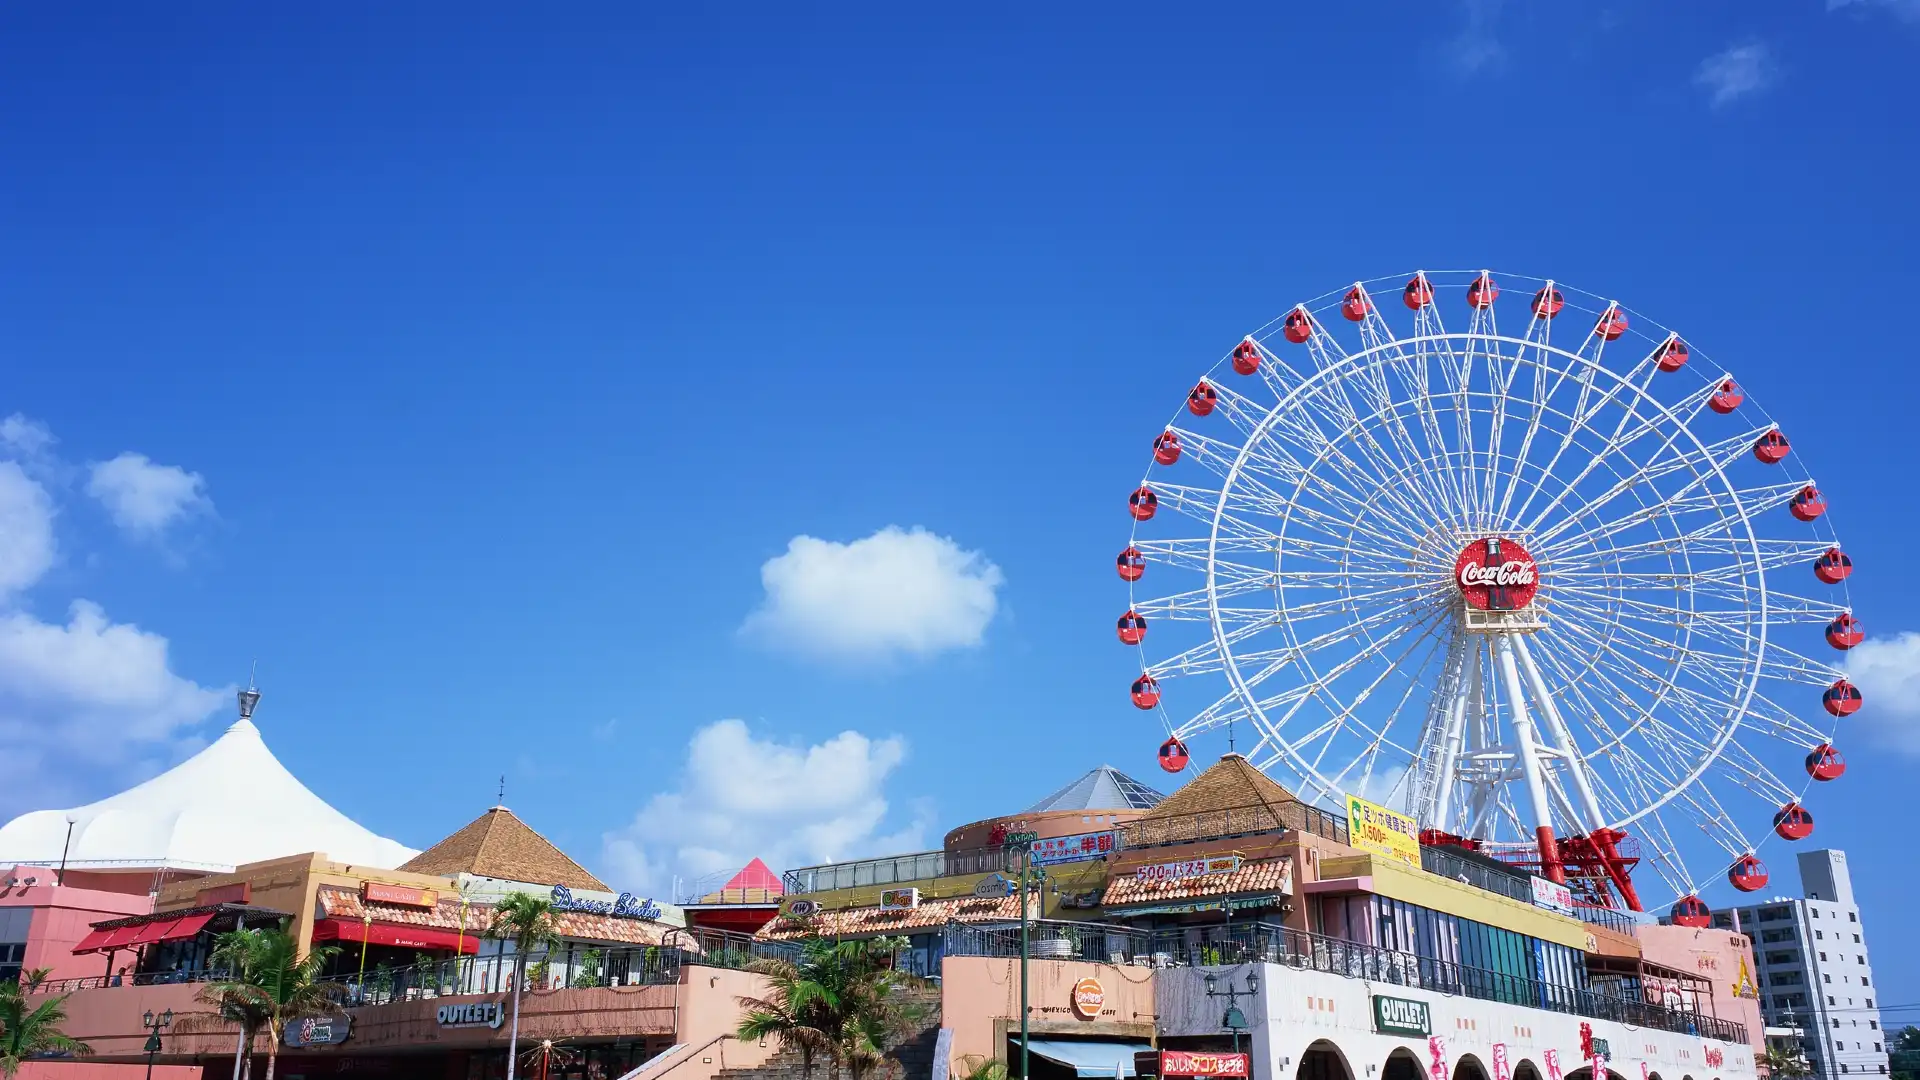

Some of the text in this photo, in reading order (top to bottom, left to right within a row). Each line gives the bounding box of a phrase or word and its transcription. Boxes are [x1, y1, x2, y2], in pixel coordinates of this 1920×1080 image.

[1461, 561, 1536, 586] Coca-Cola
[1081, 834, 1113, 854] 半額
[437, 1002, 504, 1029] OUTLET-J
[1381, 998, 1429, 1034] OUTLET-J
